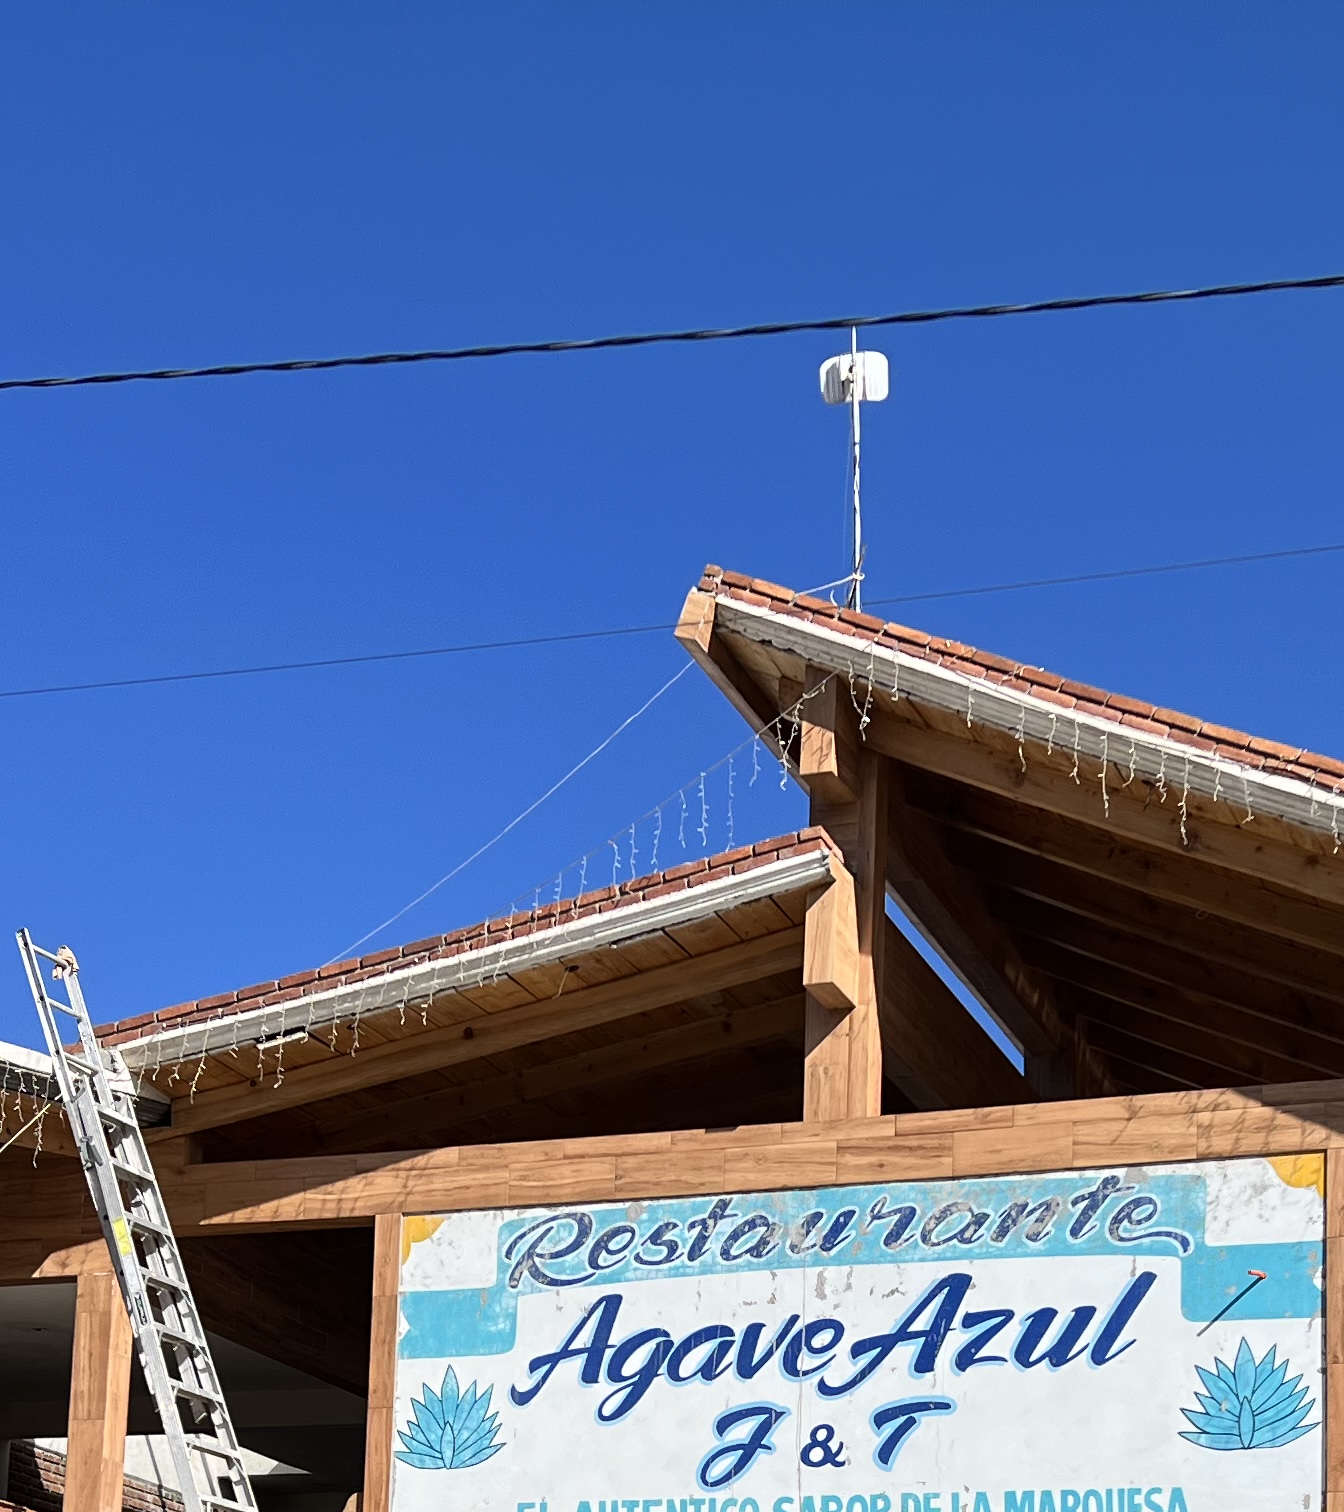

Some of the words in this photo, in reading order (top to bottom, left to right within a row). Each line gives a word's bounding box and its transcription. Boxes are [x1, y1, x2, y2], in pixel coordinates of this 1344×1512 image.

[505, 1174, 1191, 1290] Restaurante
[510, 1293, 845, 1424] Agave
[818, 1271, 1158, 1397] Azul
[800, 1423, 846, 1468] &
[873, 1401, 953, 1466] T
